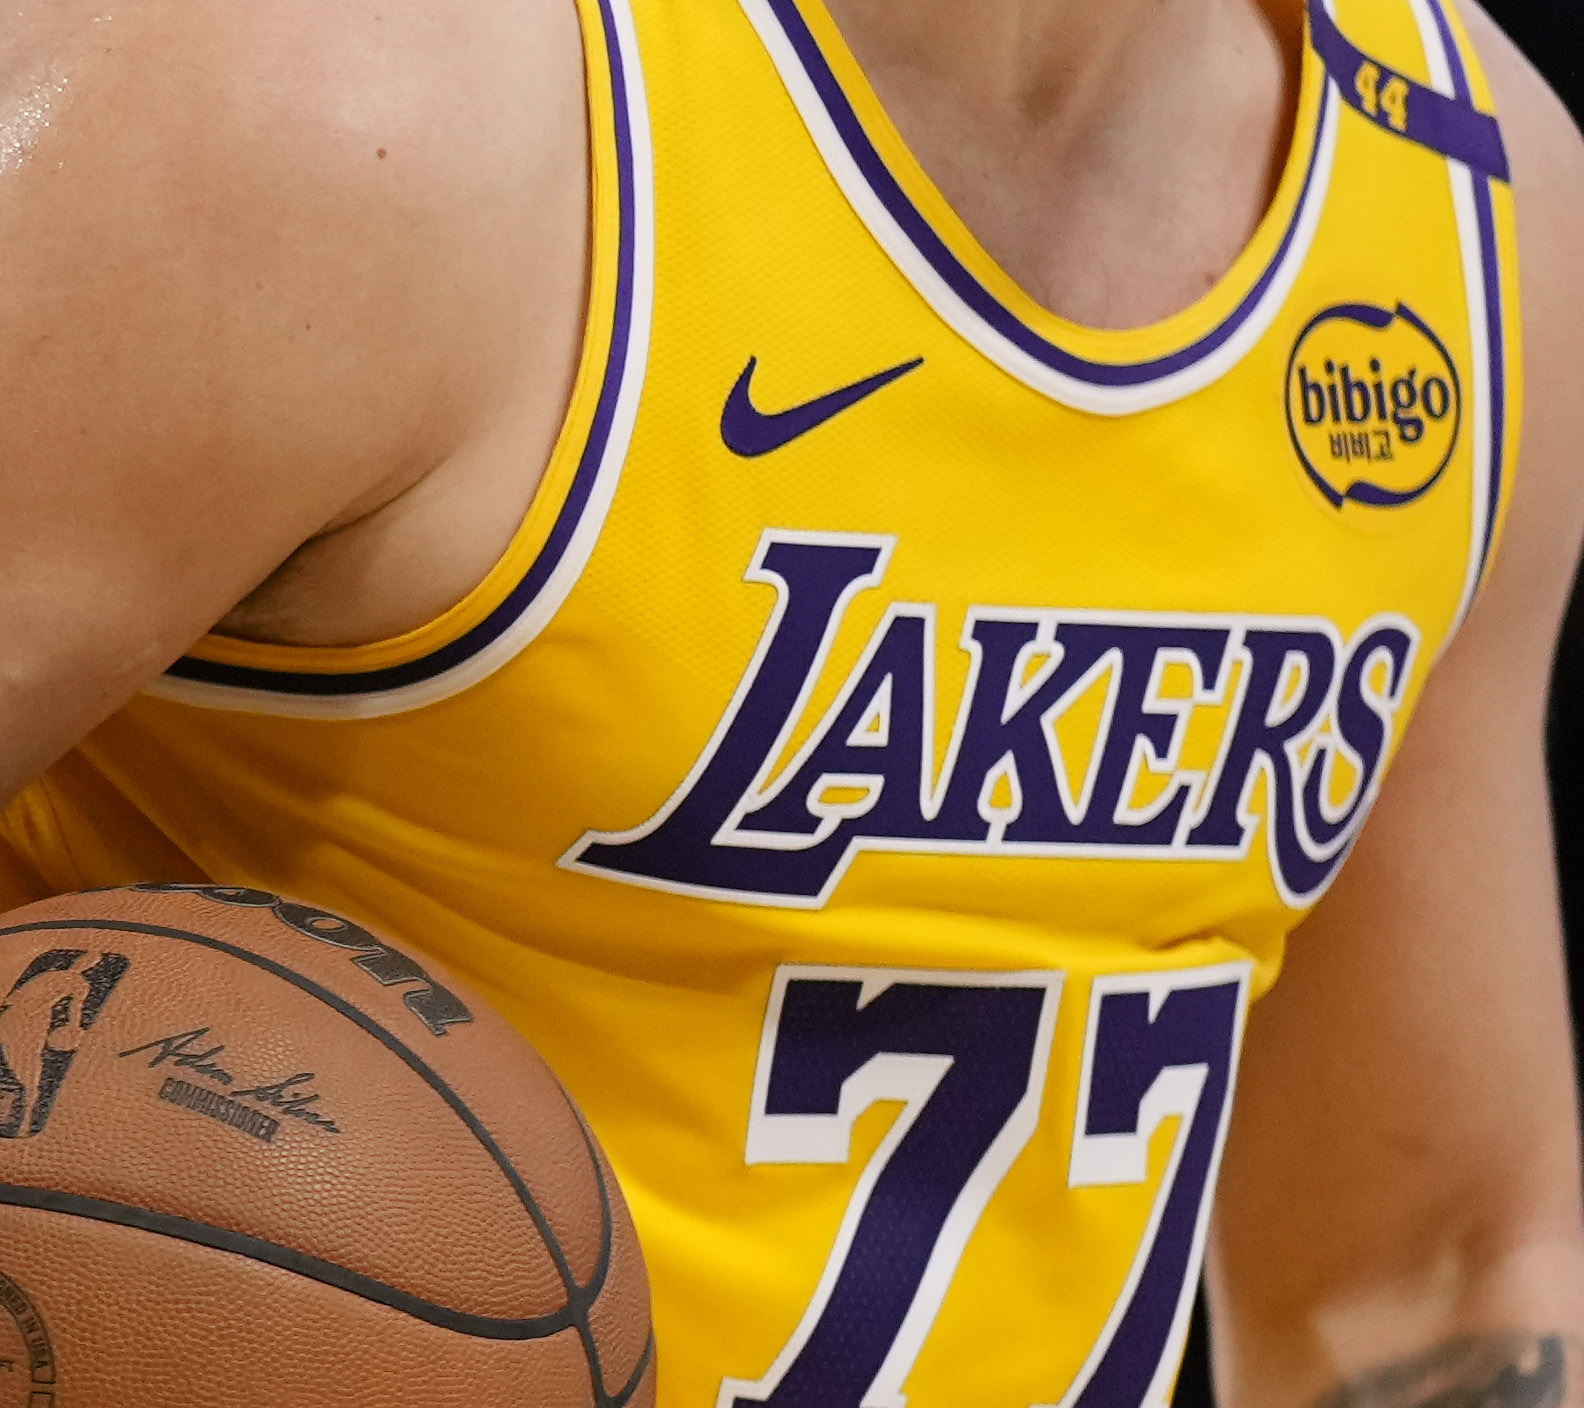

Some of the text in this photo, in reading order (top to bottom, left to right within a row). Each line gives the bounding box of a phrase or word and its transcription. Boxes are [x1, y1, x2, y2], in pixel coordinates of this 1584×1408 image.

[1355, 59, 1410, 132] 44
[1298, 358, 1450, 443] bibigo
[557, 528, 1419, 909] LAKERS
